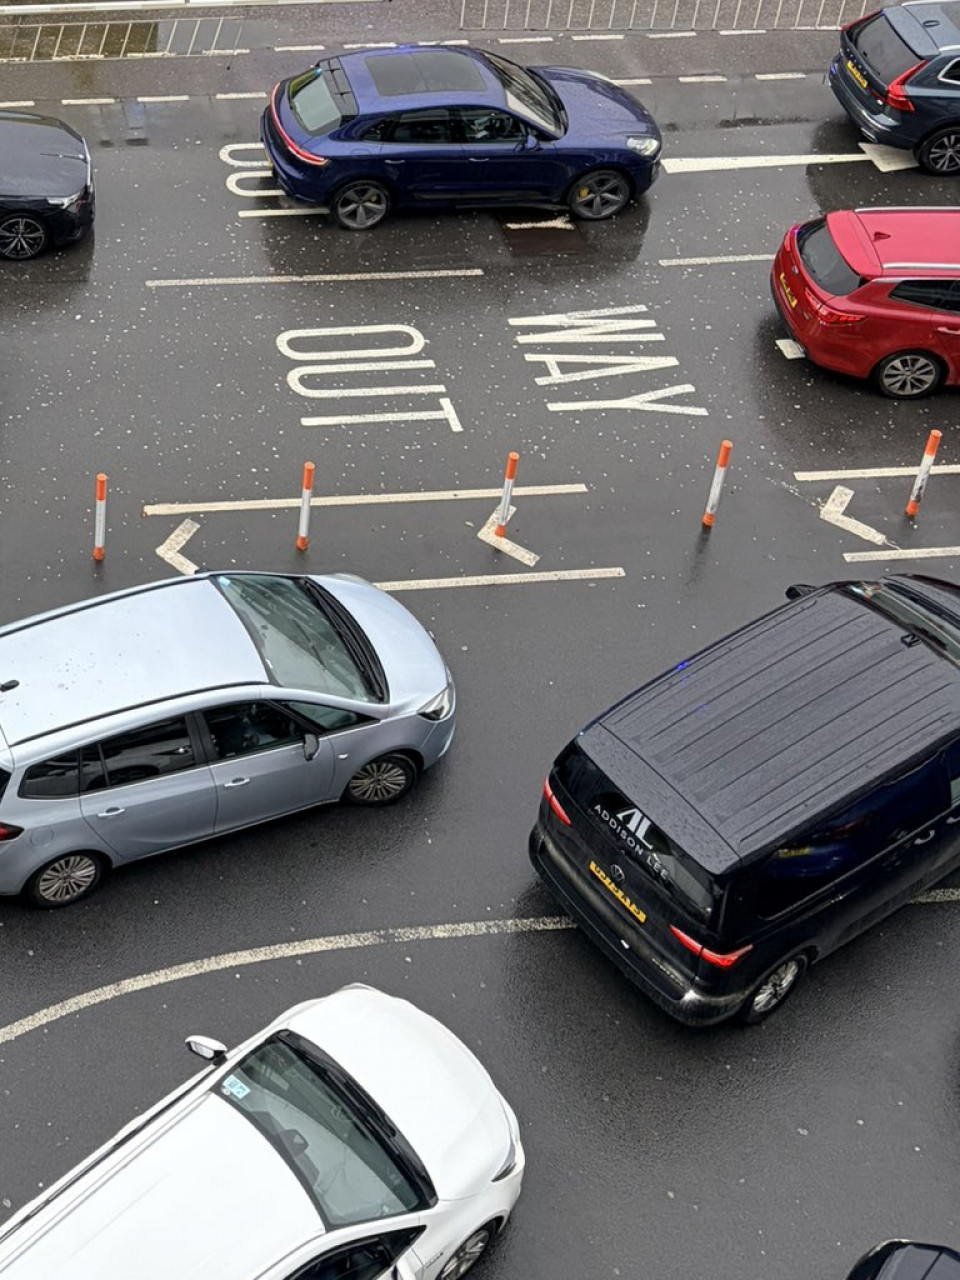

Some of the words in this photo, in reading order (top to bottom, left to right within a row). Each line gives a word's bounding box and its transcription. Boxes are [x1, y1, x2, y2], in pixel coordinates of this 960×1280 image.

[275, 323, 465, 433] OUT
[508, 304, 709, 416] WAY
[594, 804, 644, 856] ADDISON
